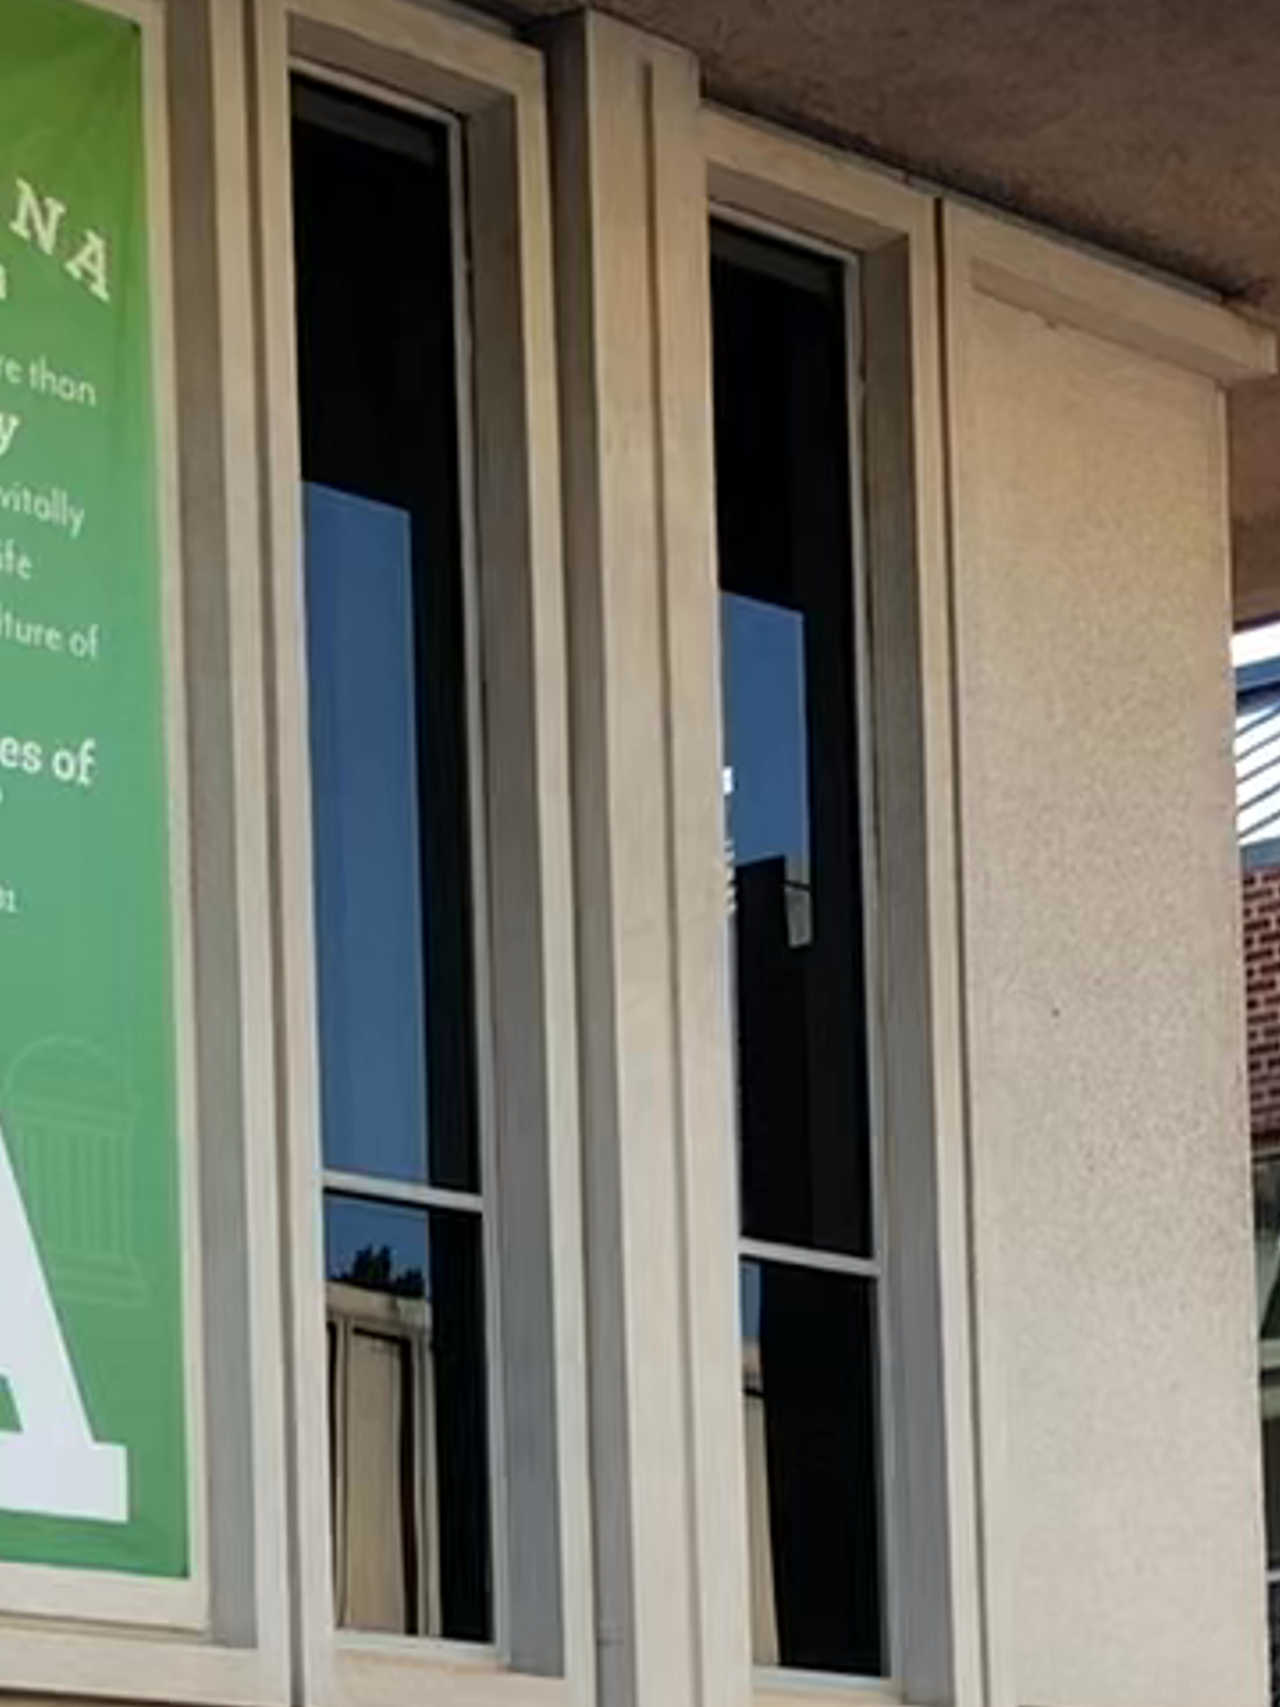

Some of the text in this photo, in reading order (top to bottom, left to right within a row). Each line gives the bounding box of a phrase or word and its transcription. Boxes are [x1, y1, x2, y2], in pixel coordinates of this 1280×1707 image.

[30, 358, 96, 406] than
[0, 483, 85, 539] vitally
[69, 623, 100, 661] of
[52, 739, 96, 786] of
